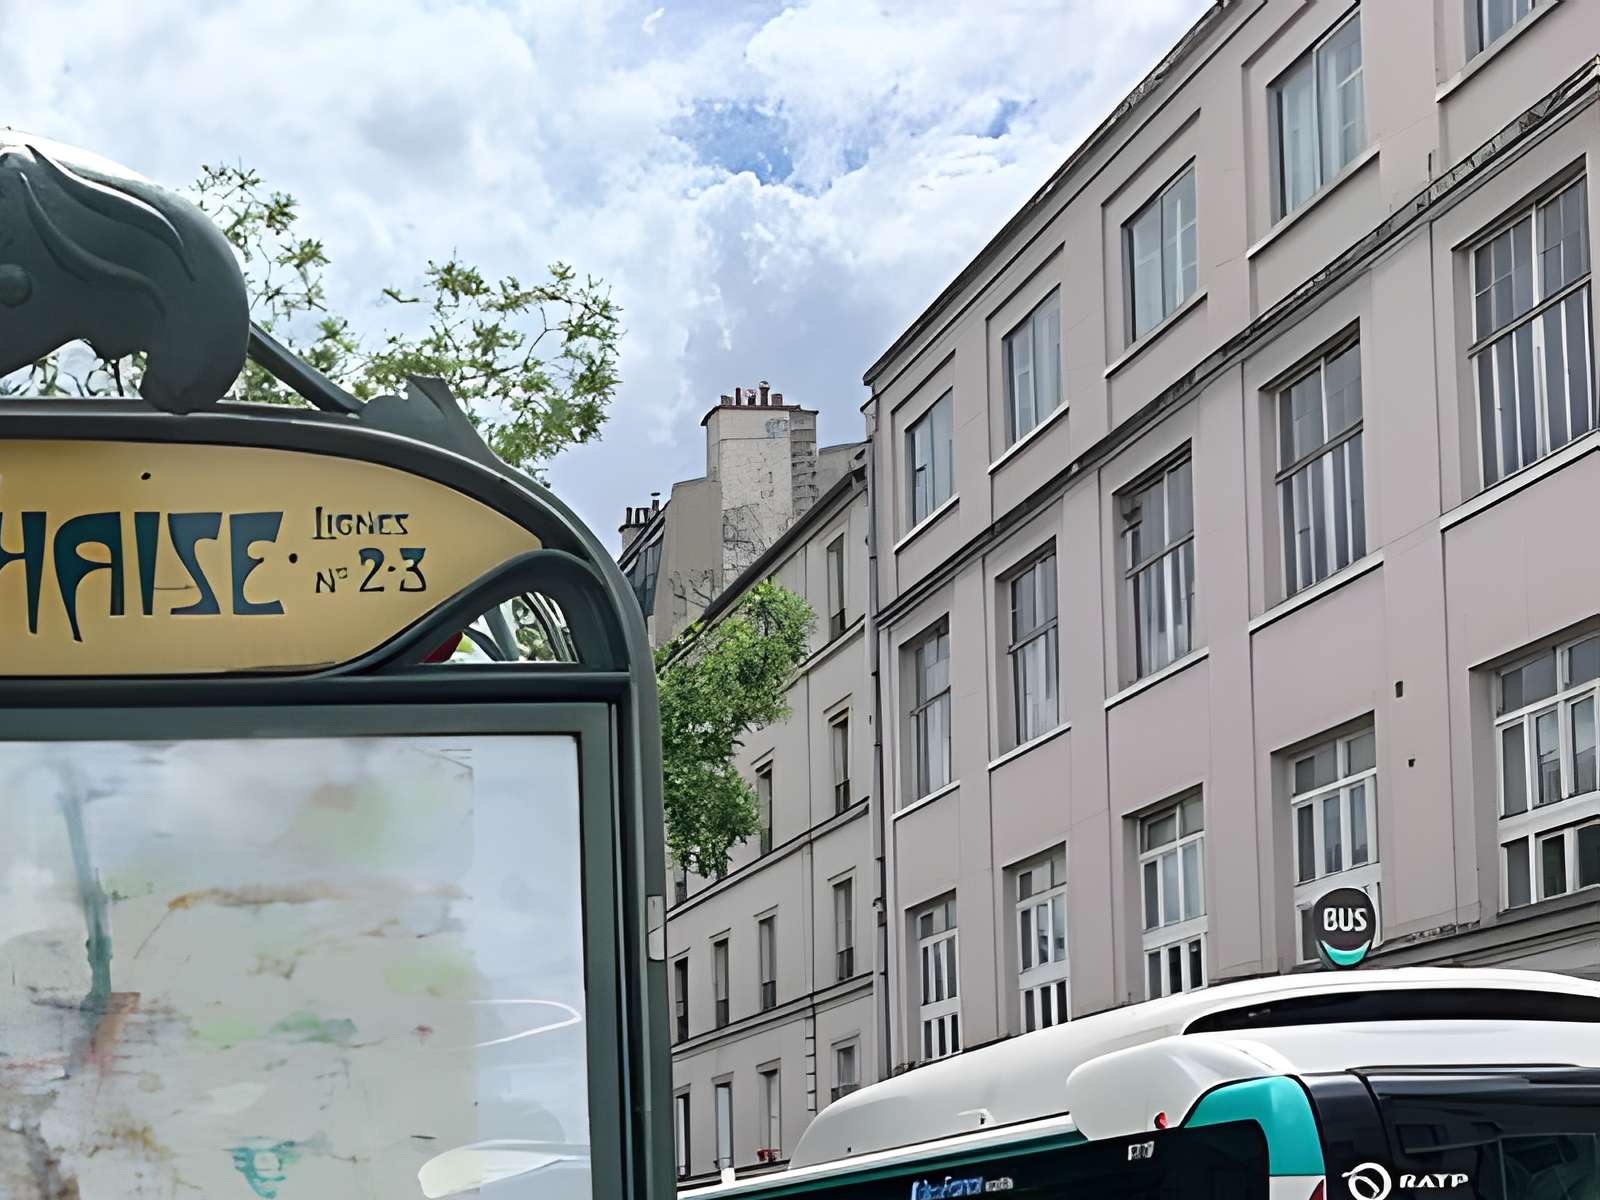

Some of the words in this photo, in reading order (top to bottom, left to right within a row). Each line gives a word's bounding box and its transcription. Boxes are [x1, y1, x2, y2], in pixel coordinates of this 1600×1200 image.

[312, 506, 409, 540] LIGNES
[1323, 907, 1368, 932] BUS
[1399, 1173, 1469, 1189] RATP
